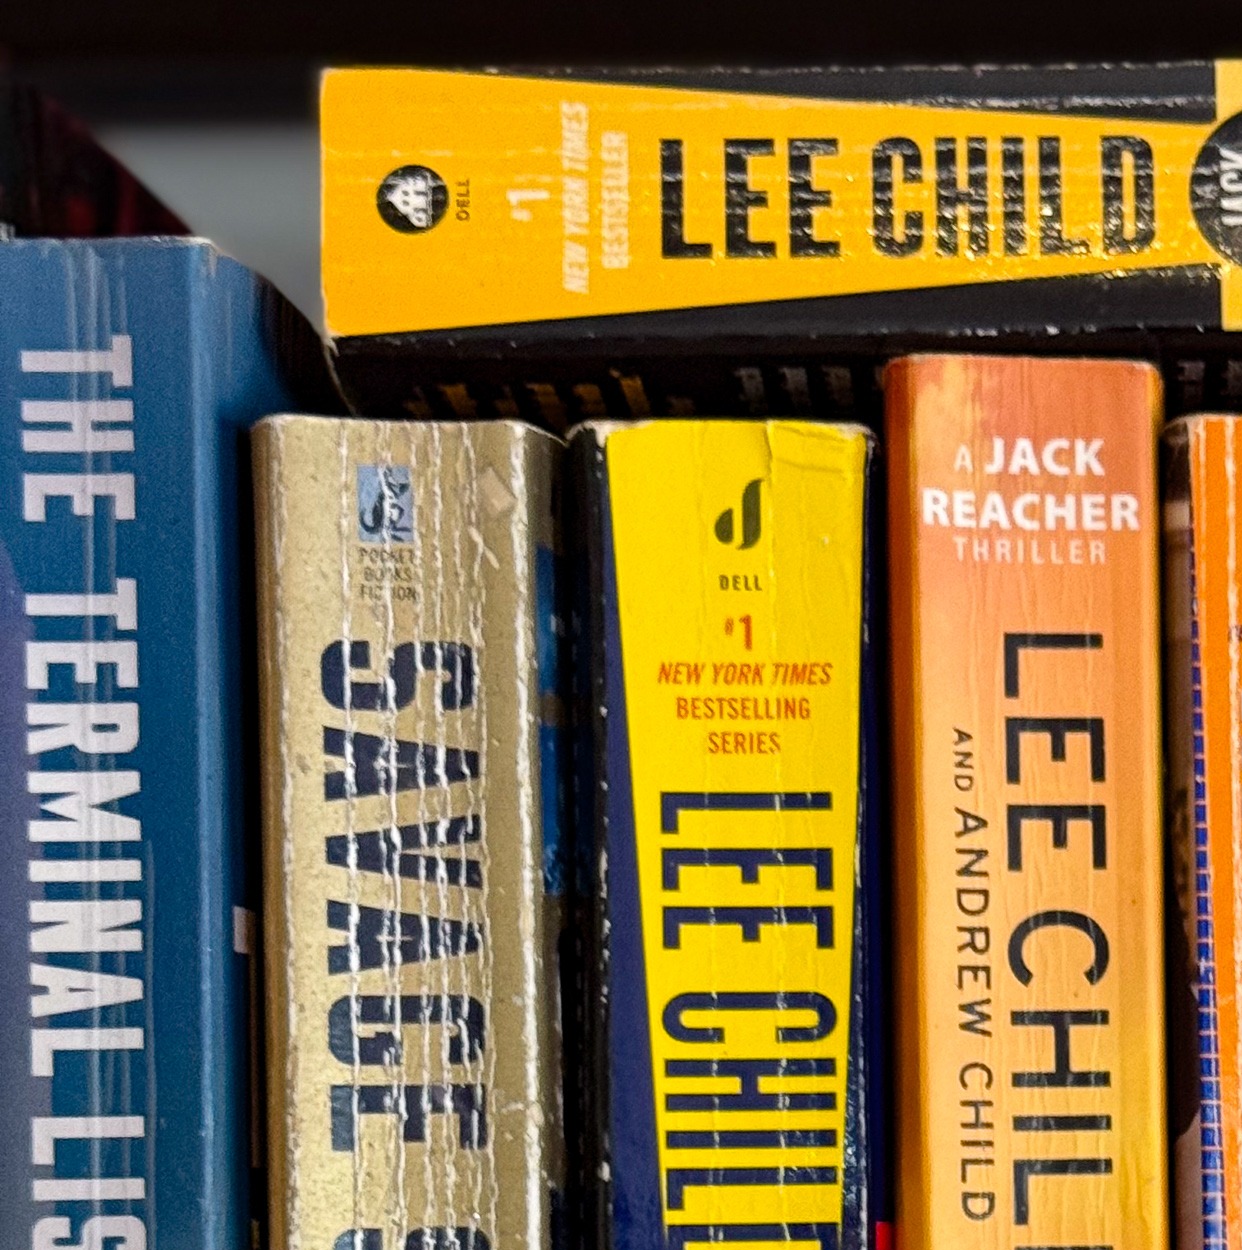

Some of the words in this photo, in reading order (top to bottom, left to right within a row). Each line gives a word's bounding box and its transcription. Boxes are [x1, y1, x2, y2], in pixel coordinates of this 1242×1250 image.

[560, 101, 588, 171] TIMES
[561, 176, 588, 236] YORK
[601, 132, 628, 269] BESTSELLER
[660, 138, 841, 260] LEE
[870, 135, 1157, 258] CHILD
[561, 238, 588, 293] NEW
[20, 334, 136, 522] THE
[953, 444, 974, 474] A
[984, 437, 1105, 476] JACK
[922, 488, 1140, 531] REACHER
[718, 573, 763, 591] DELL
[952, 536, 1105, 565] THRILLER
[724, 614, 753, 650] #1
[656, 662, 705, 685] NEW
[711, 662, 767, 685] YORK
[771, 662, 834, 685] TIMES
[675, 696, 811, 720] BESTSELLING
[707, 731, 782, 754] SERIES
[953, 726, 974, 791] AND
[1002, 632, 1108, 872] LEE
[25, 577, 145, 1077] TERMINAL
[320, 638, 488, 1152] SAVAGE
[660, 791, 835, 950] LEE
[954, 806, 994, 1038] ANDREW
[958, 1062, 996, 1222] CHILD
